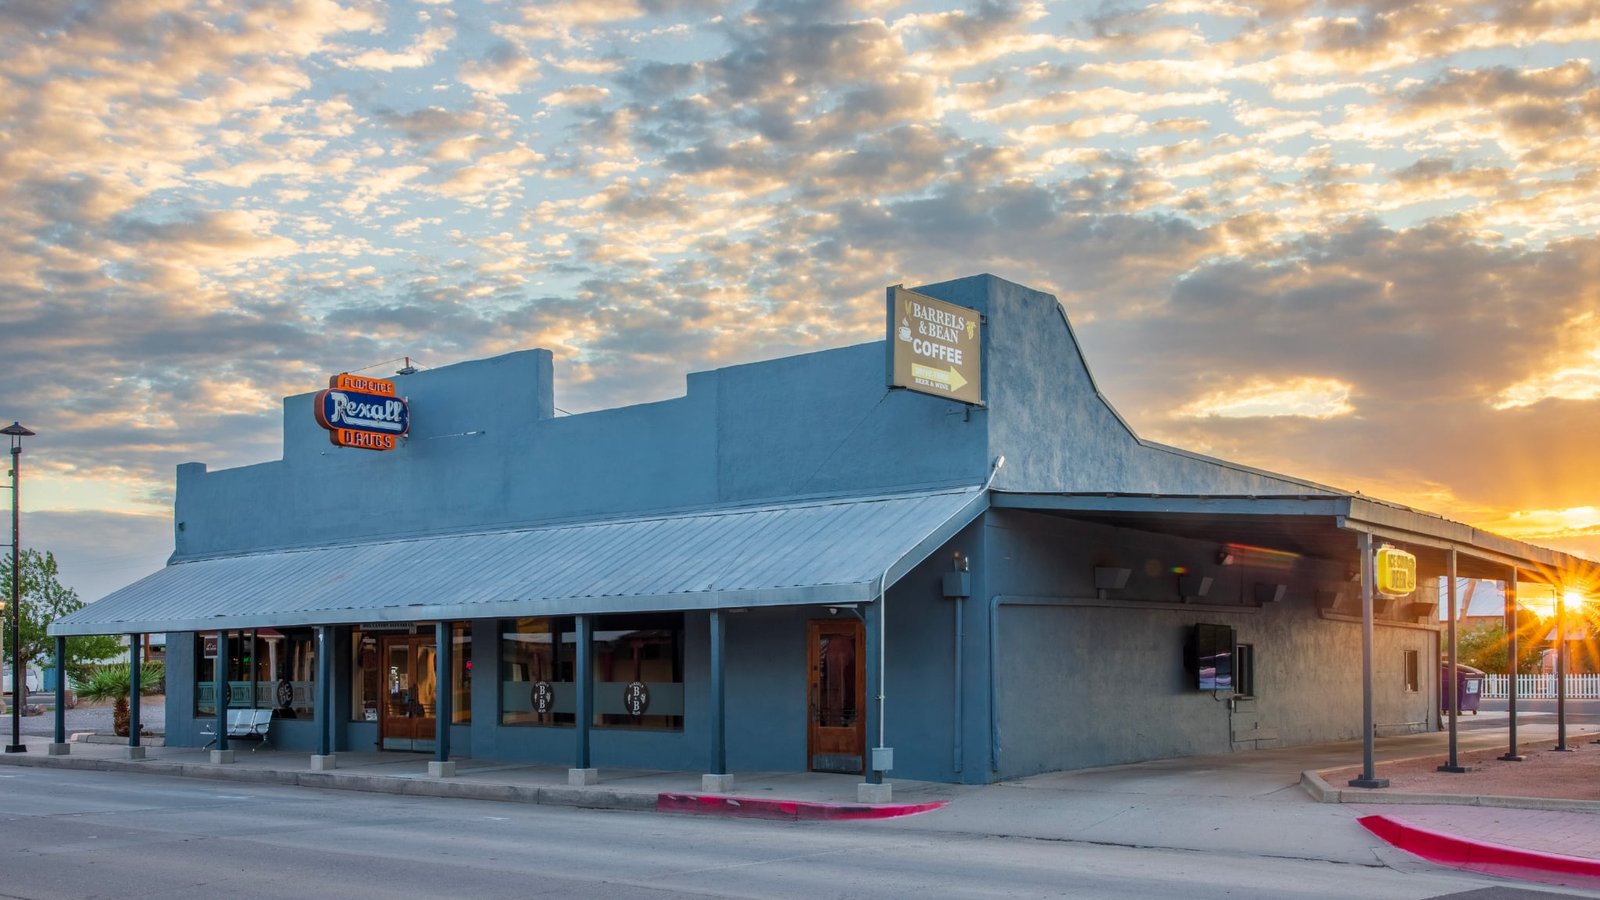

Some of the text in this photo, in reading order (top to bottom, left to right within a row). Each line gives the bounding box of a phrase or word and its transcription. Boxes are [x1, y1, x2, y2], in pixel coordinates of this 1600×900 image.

[913, 303, 965, 331] BARRELS
[918, 320, 959, 344] & BEAN
[913, 338, 963, 365] COFFEE
[343, 377, 392, 393] FLORENCE
[330, 392, 402, 424] Rexall
[344, 430, 392, 448] DRUGS
[633, 686, 640, 696] B
[633, 701, 640, 711] B
